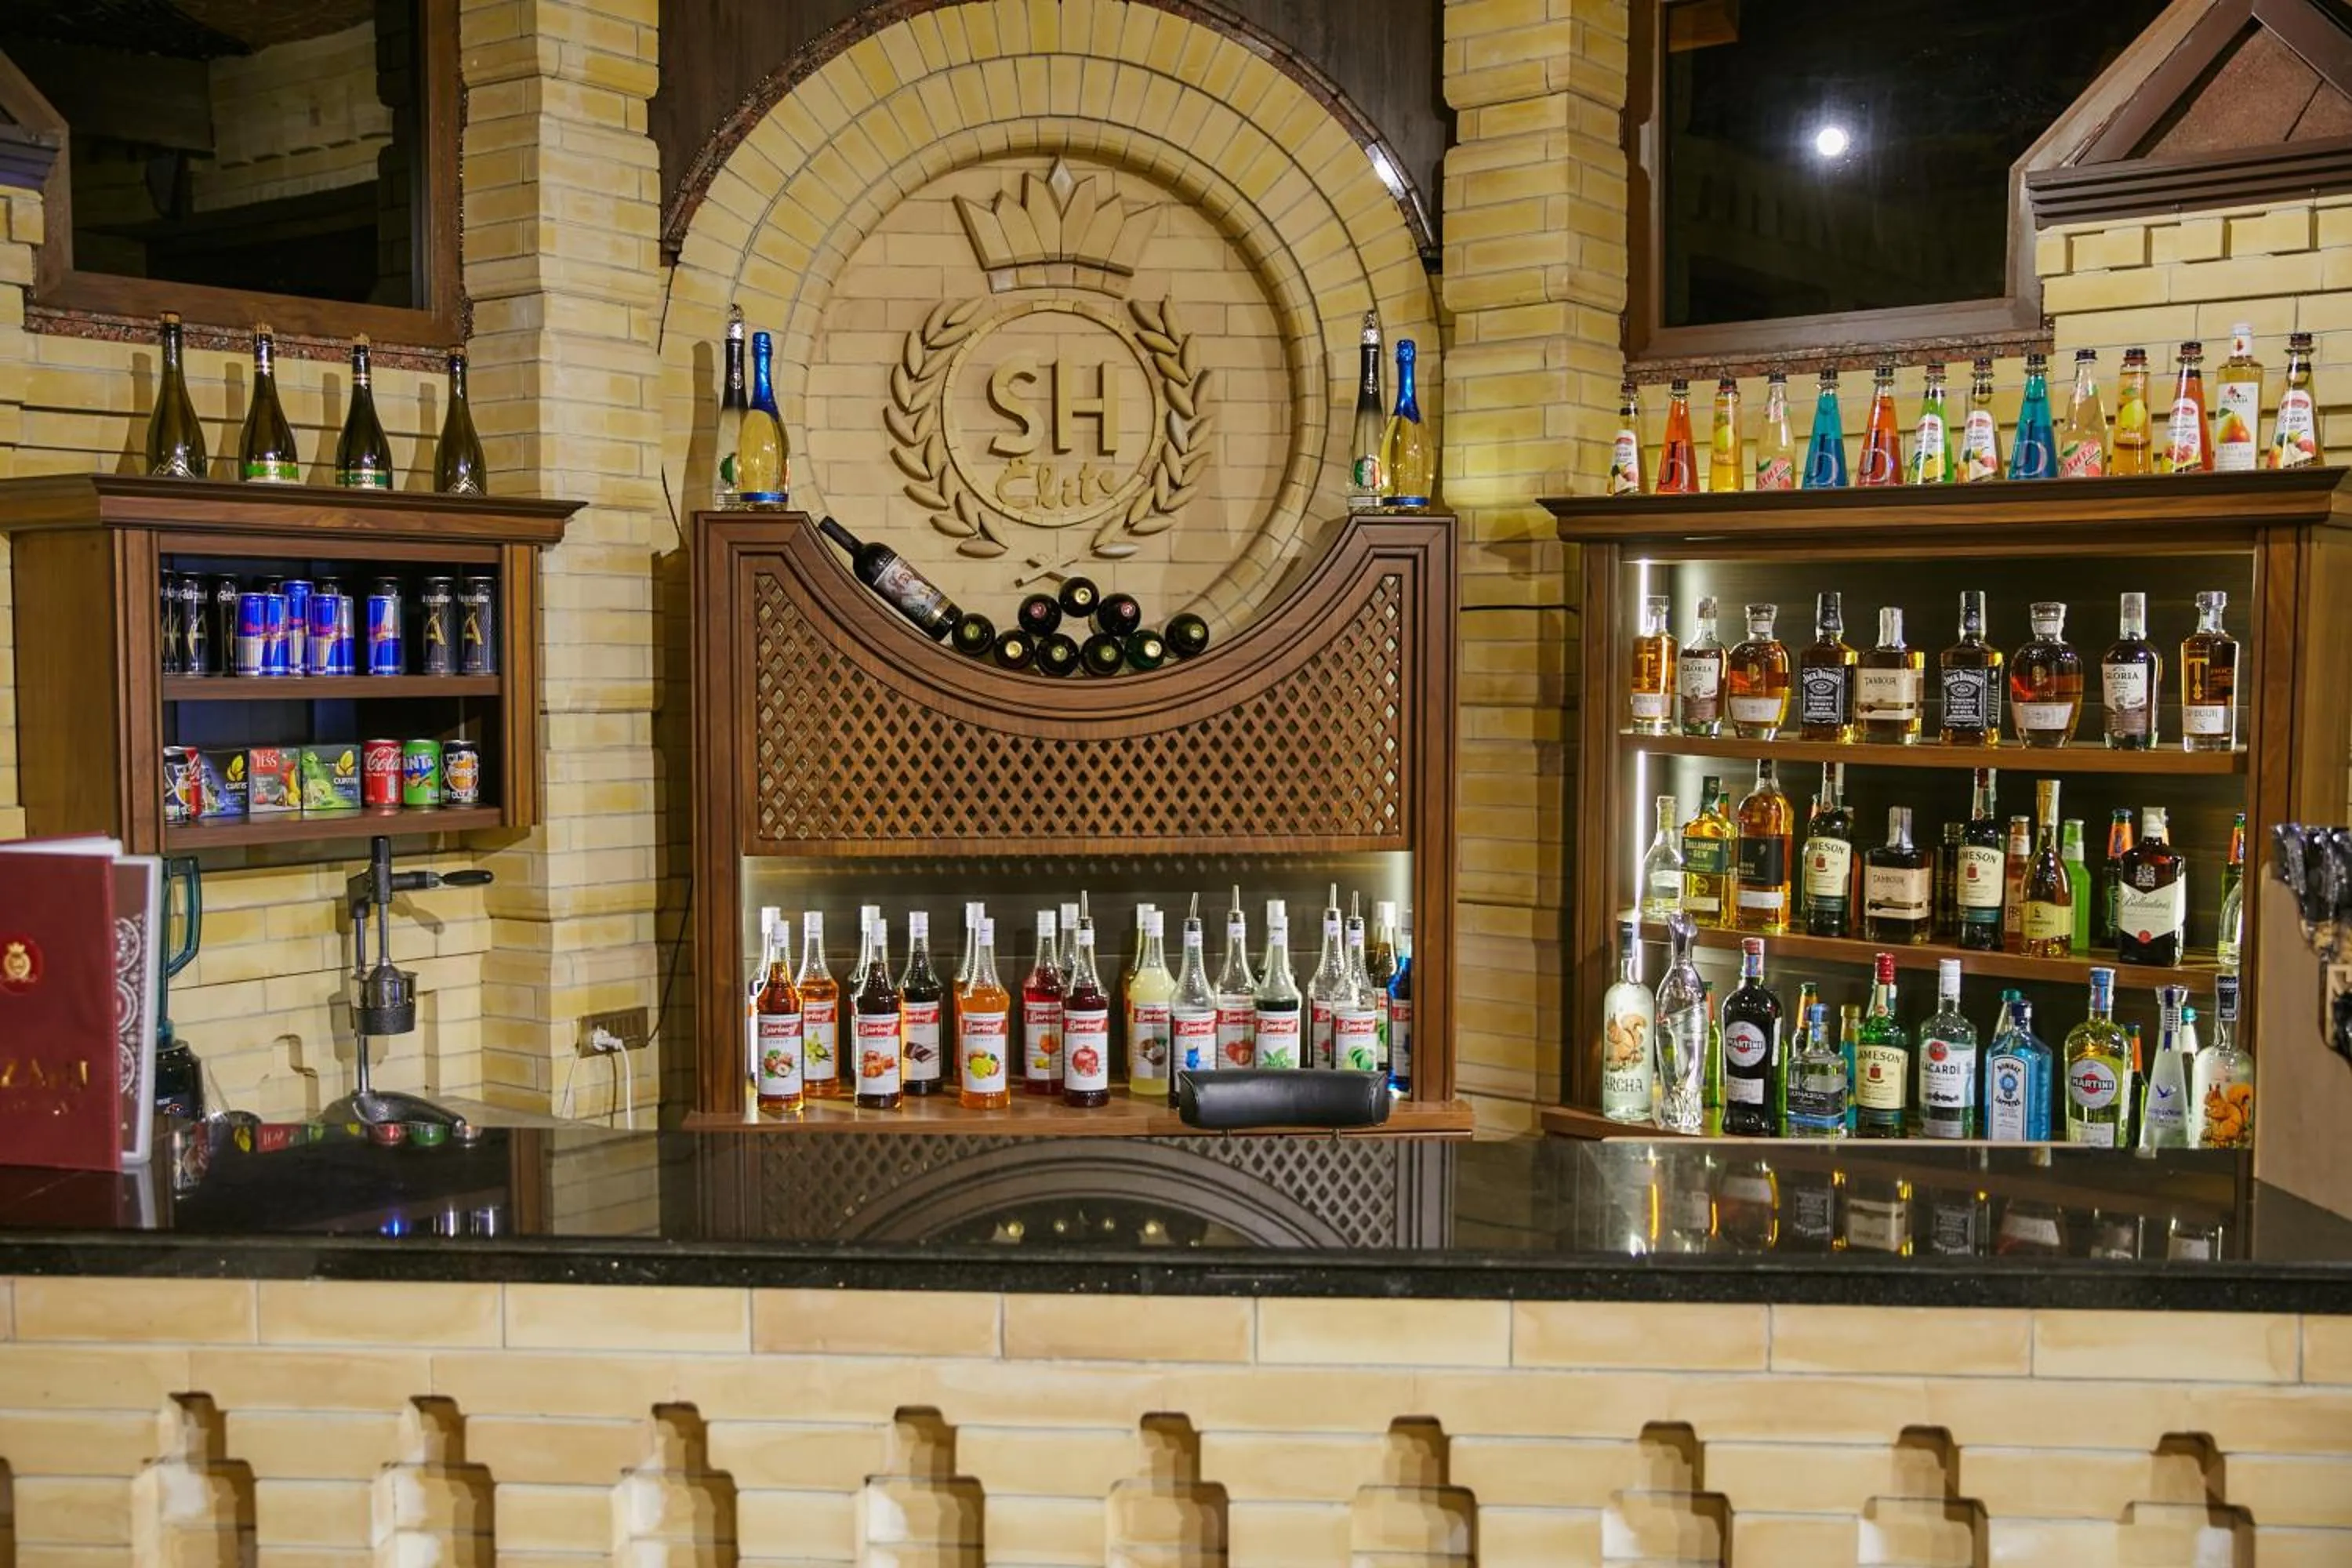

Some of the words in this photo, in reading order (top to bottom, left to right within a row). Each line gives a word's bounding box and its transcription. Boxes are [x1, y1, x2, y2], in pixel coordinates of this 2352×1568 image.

[986, 353, 1119, 457] SH
[367, 746, 401, 771] Cola
[403, 754, 434, 770] ANTA
[1807, 840, 1846, 855] MESON
[1959, 851, 1998, 864] MESON
[1727, 1036, 1764, 1050] MARTINI
[1857, 1050, 1901, 1064] AMESON
[1604, 1074, 1644, 1093] ARCHA
[2071, 1076, 2114, 1091] MARTINI
